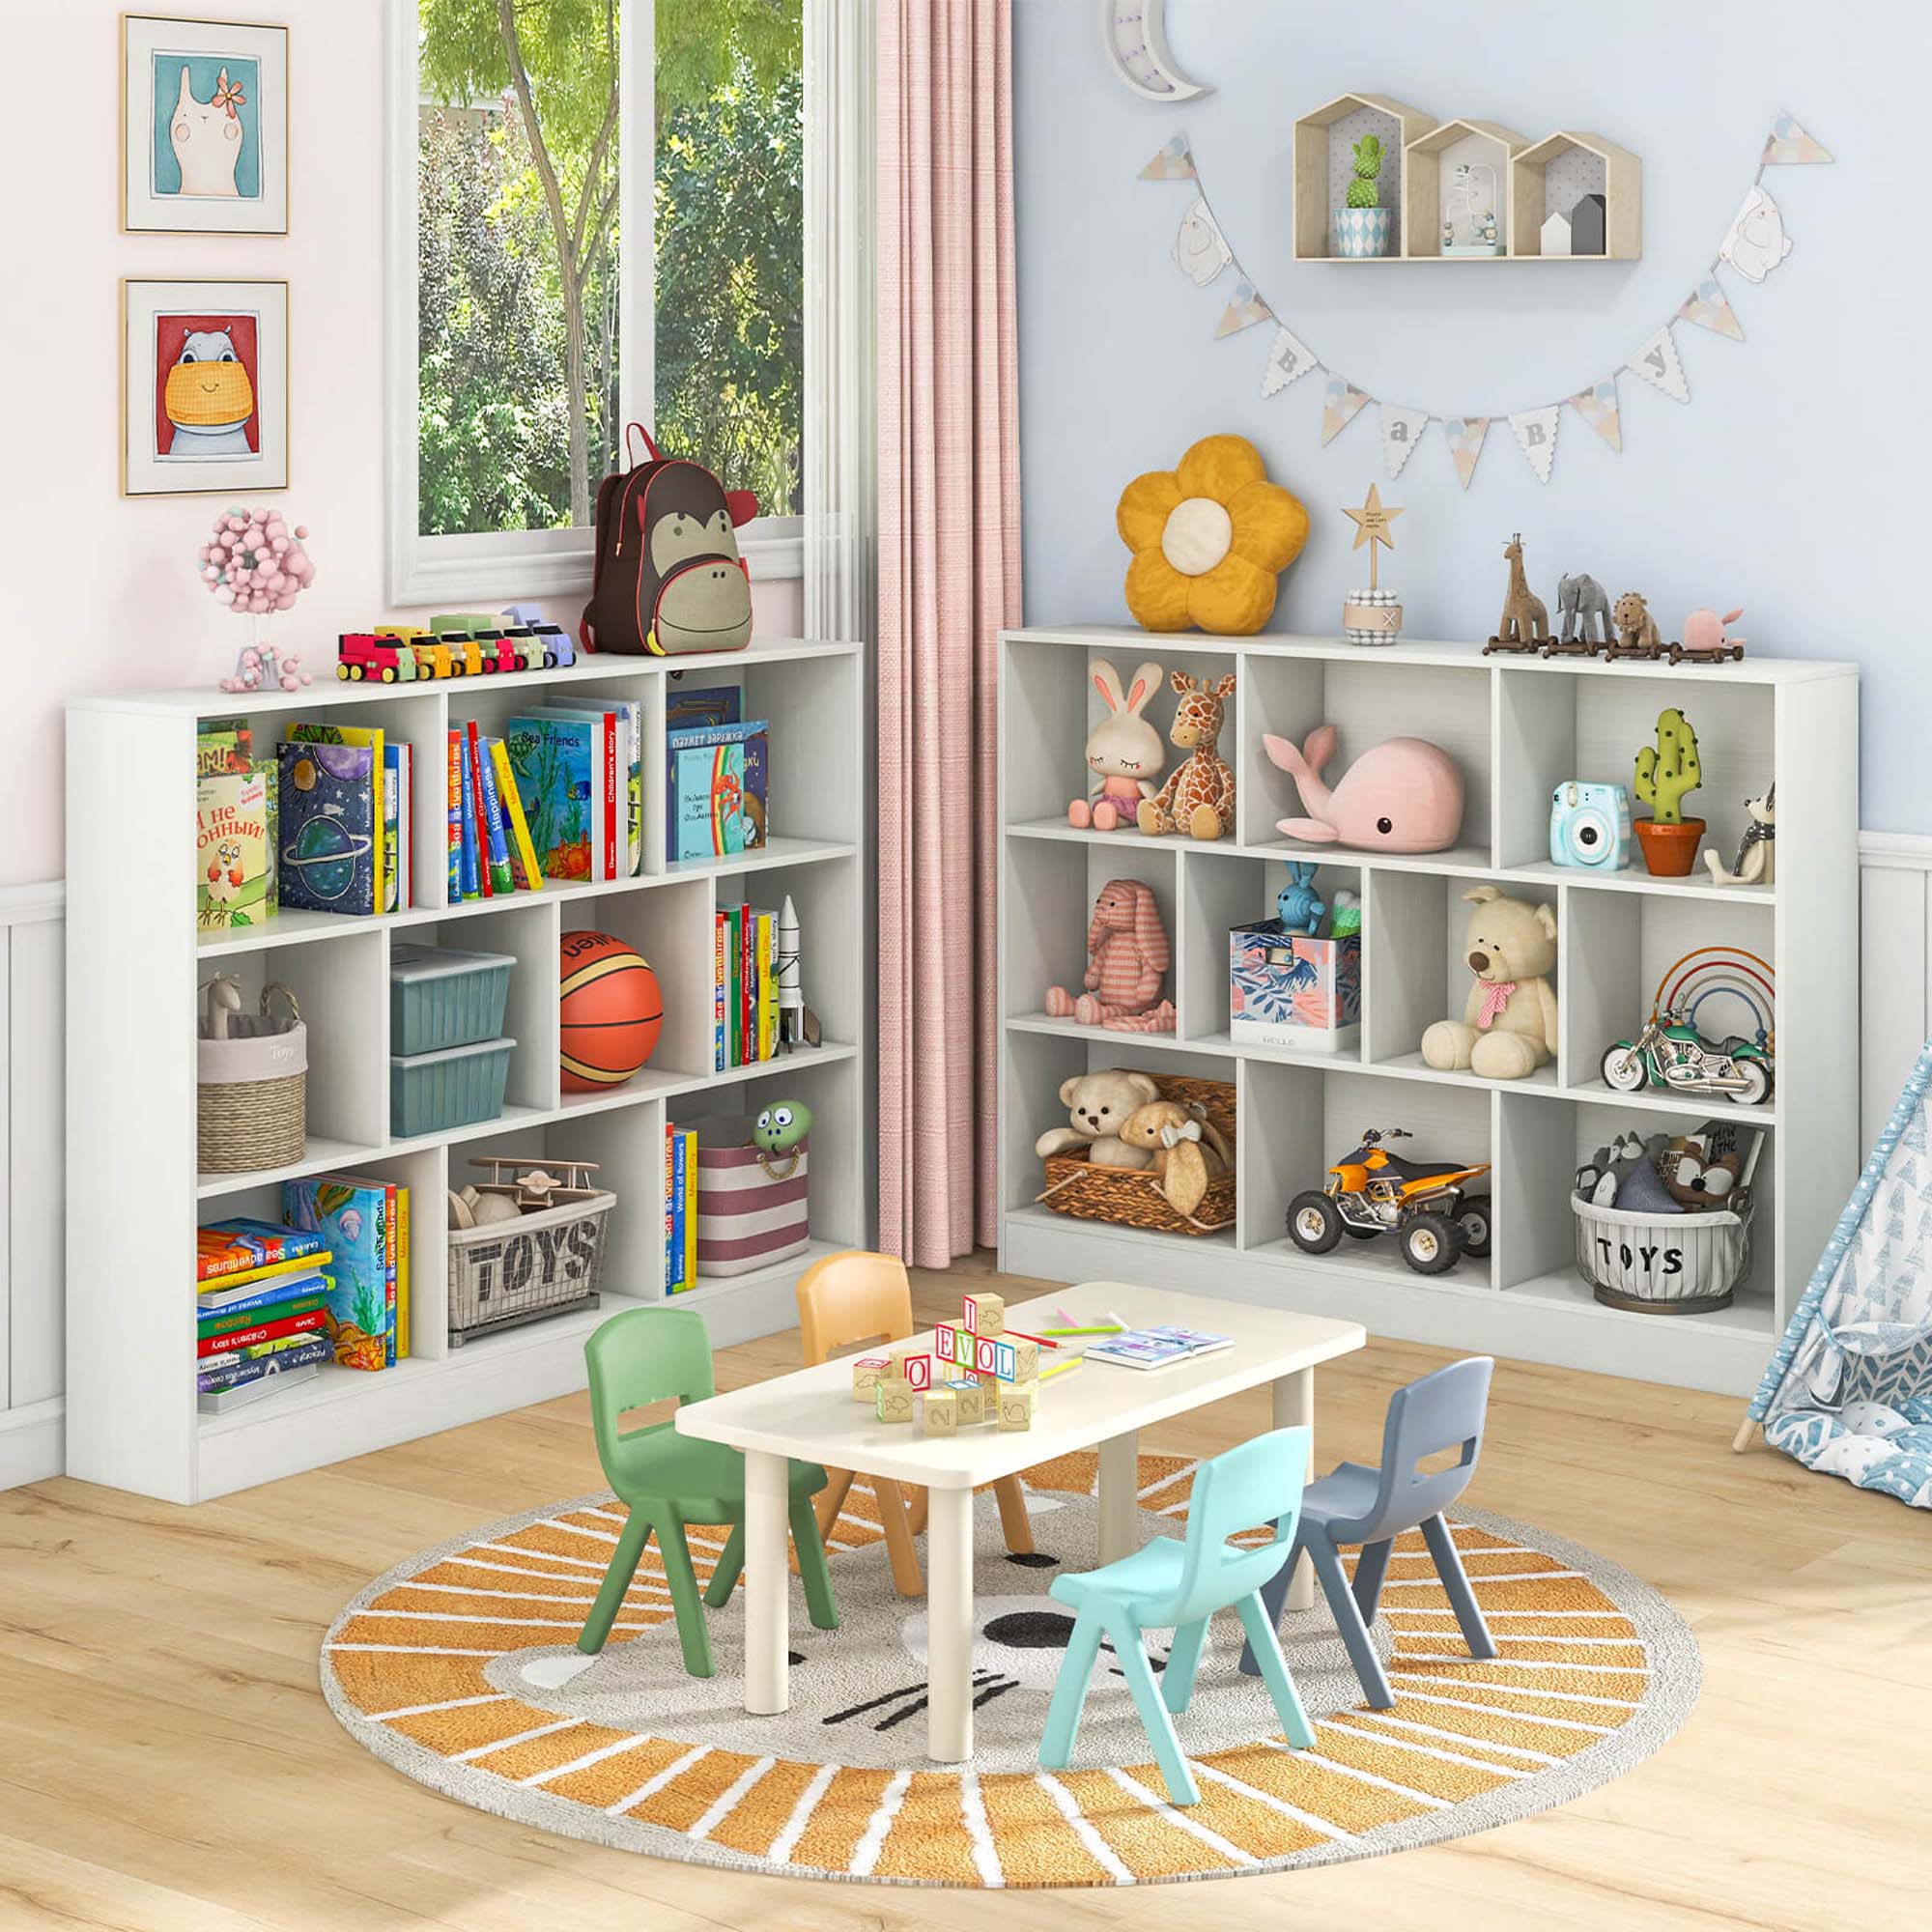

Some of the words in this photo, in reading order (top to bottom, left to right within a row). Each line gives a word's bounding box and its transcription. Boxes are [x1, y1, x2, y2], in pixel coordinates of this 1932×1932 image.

[521, 731, 541, 744] Sea
[543, 733, 581, 748] Friends
[484, 766, 501, 832] Happiness
[211, 805, 236, 824] не
[206, 1253, 264, 1275] adventures
[265, 1247, 287, 1263] Sea
[469, 1220, 597, 1301] TOYS
[1597, 1237, 1684, 1274] TOYS
